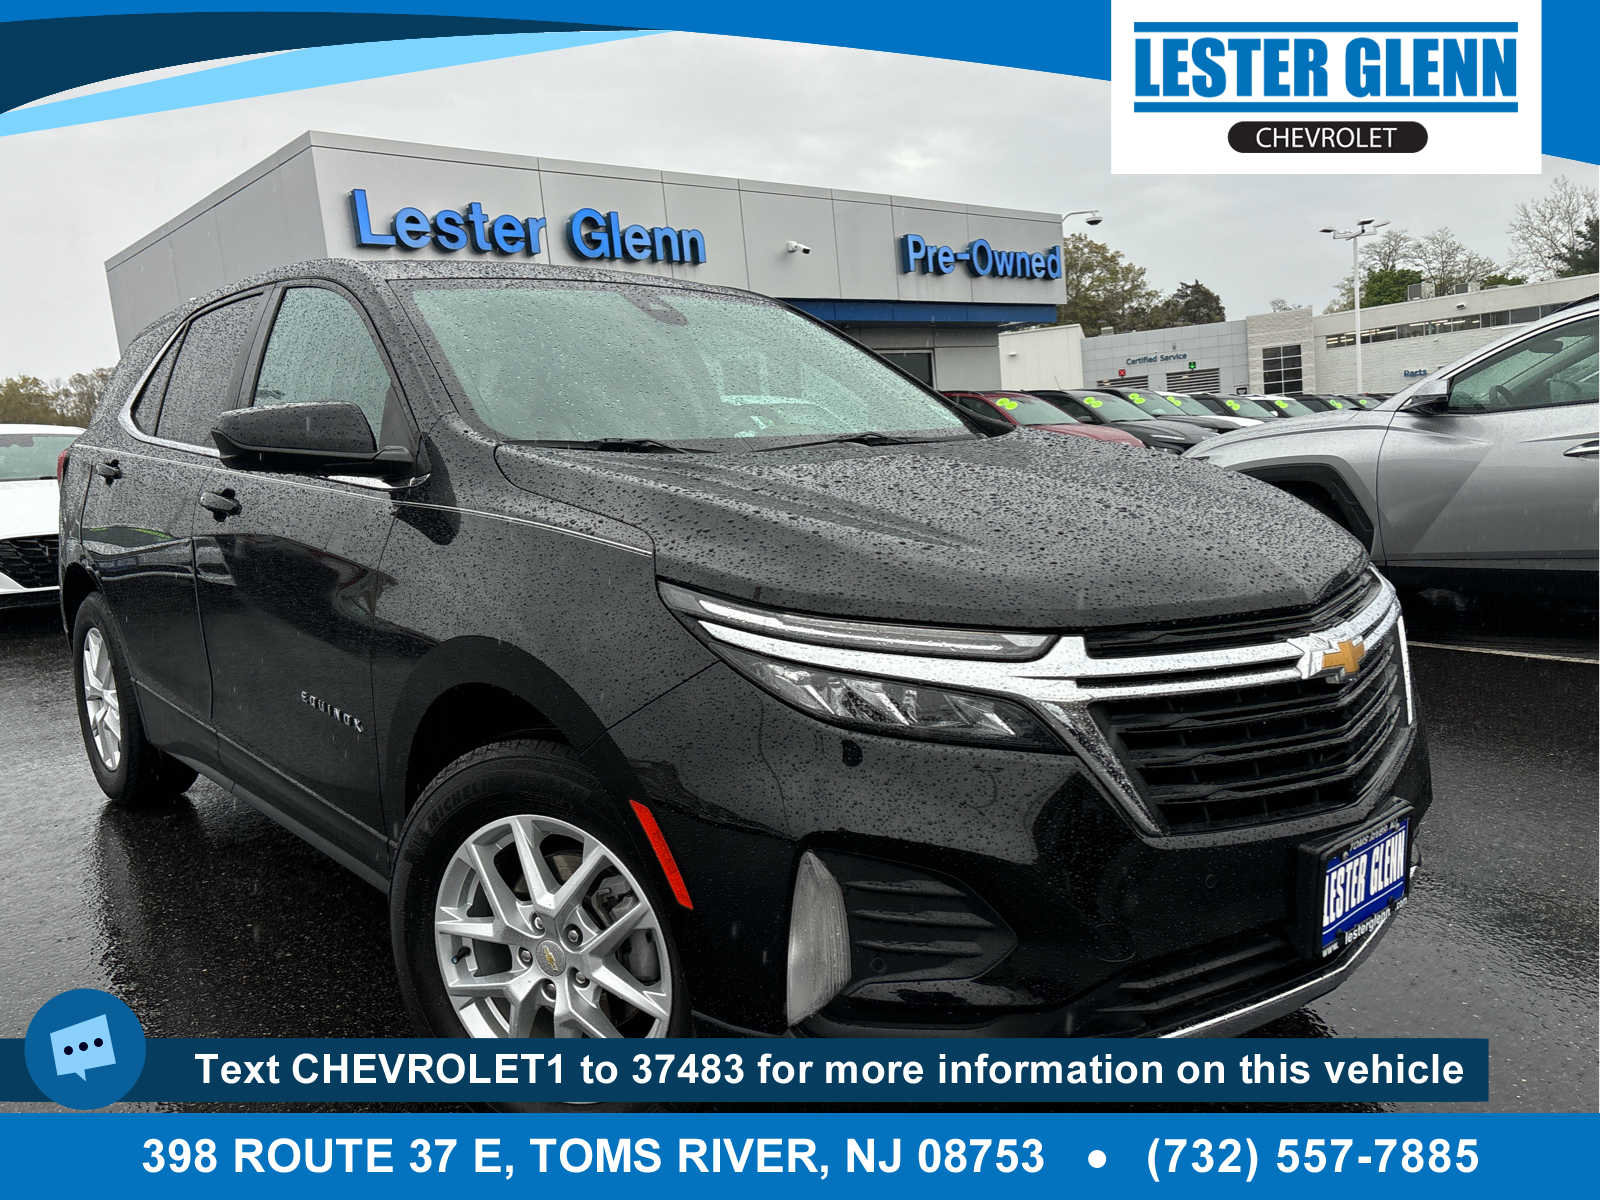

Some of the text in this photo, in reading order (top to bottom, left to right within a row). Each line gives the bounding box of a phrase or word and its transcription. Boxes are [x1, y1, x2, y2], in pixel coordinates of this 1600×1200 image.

[350, 187, 707, 264] Lester Glenn
[900, 233, 1062, 280] Pre-Owned
[1126, 352, 1187, 366] Certified Service
[301, 690, 364, 733] EQUINOX
[427, 774, 500, 831] MICHELI
[1322, 830, 1405, 928] LESTER GLENN
